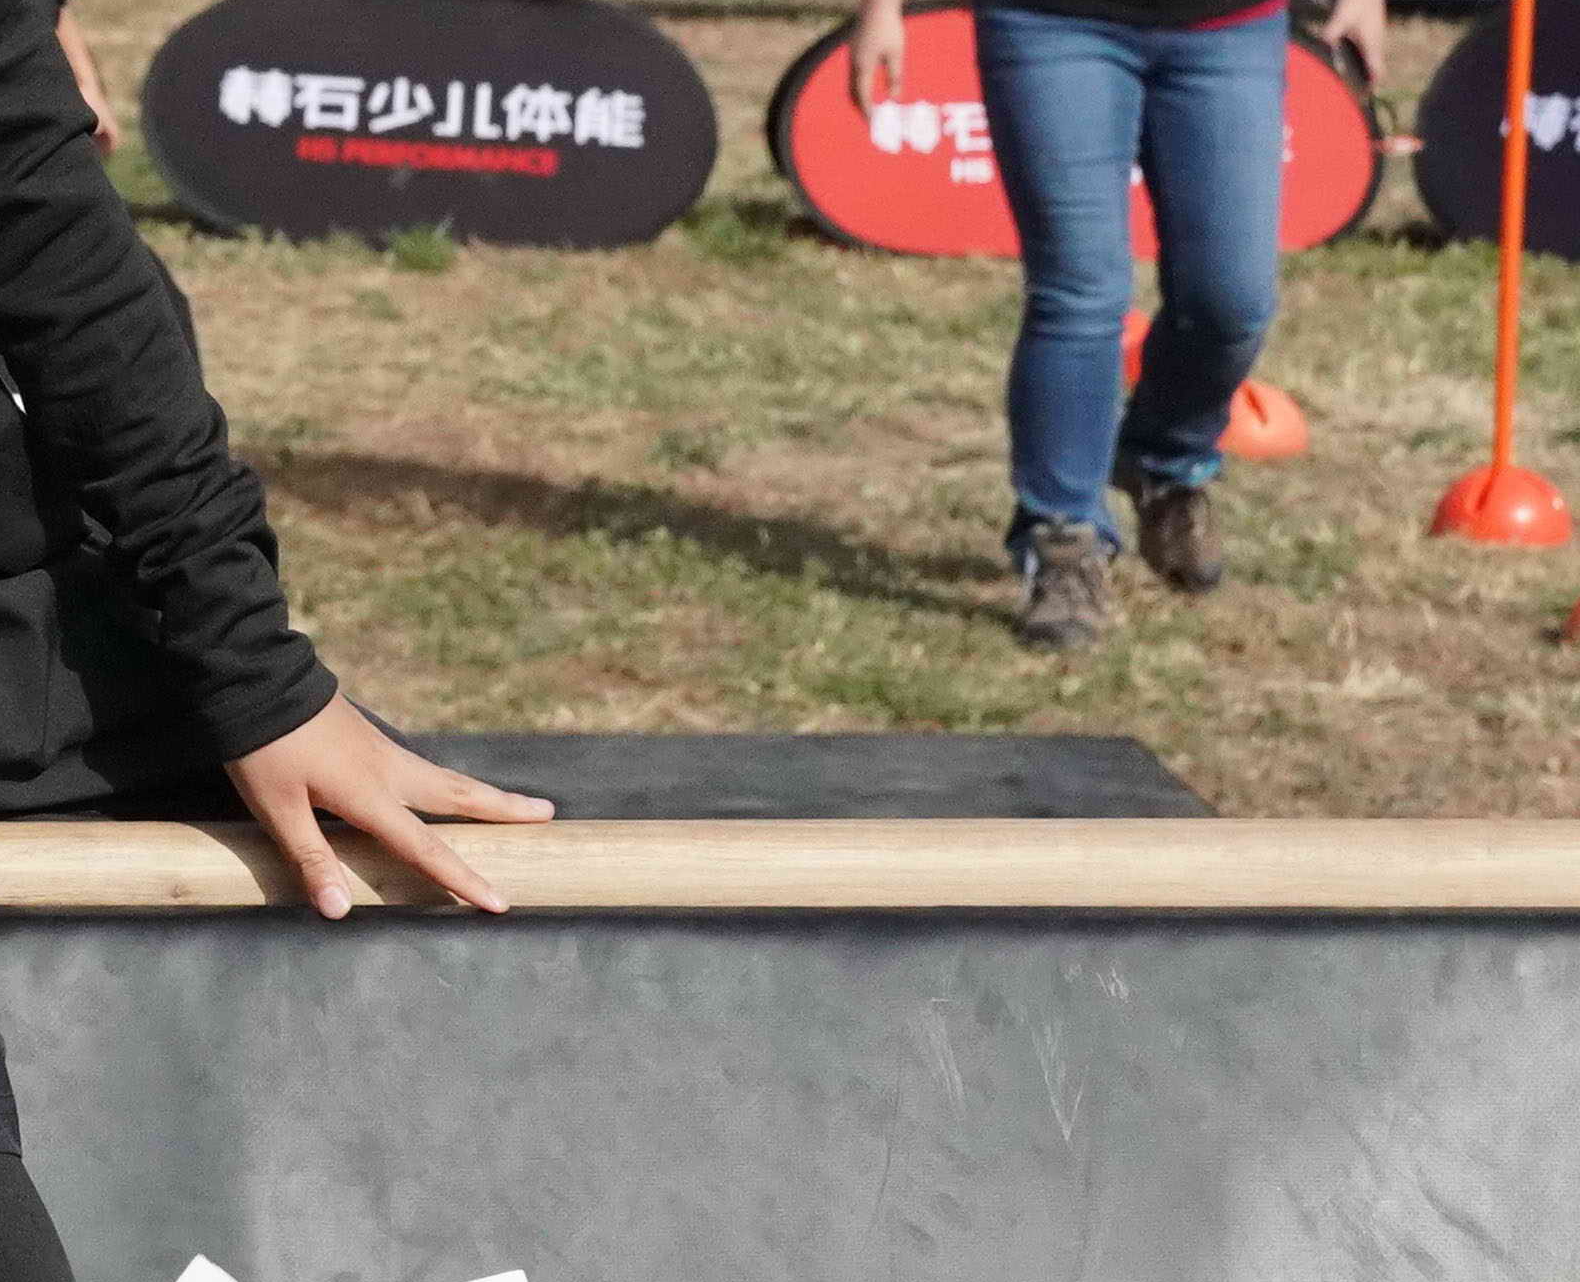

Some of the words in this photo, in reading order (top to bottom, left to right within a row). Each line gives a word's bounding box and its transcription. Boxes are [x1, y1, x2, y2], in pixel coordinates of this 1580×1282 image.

[221, 65, 646, 149] 赫石少儿体能
